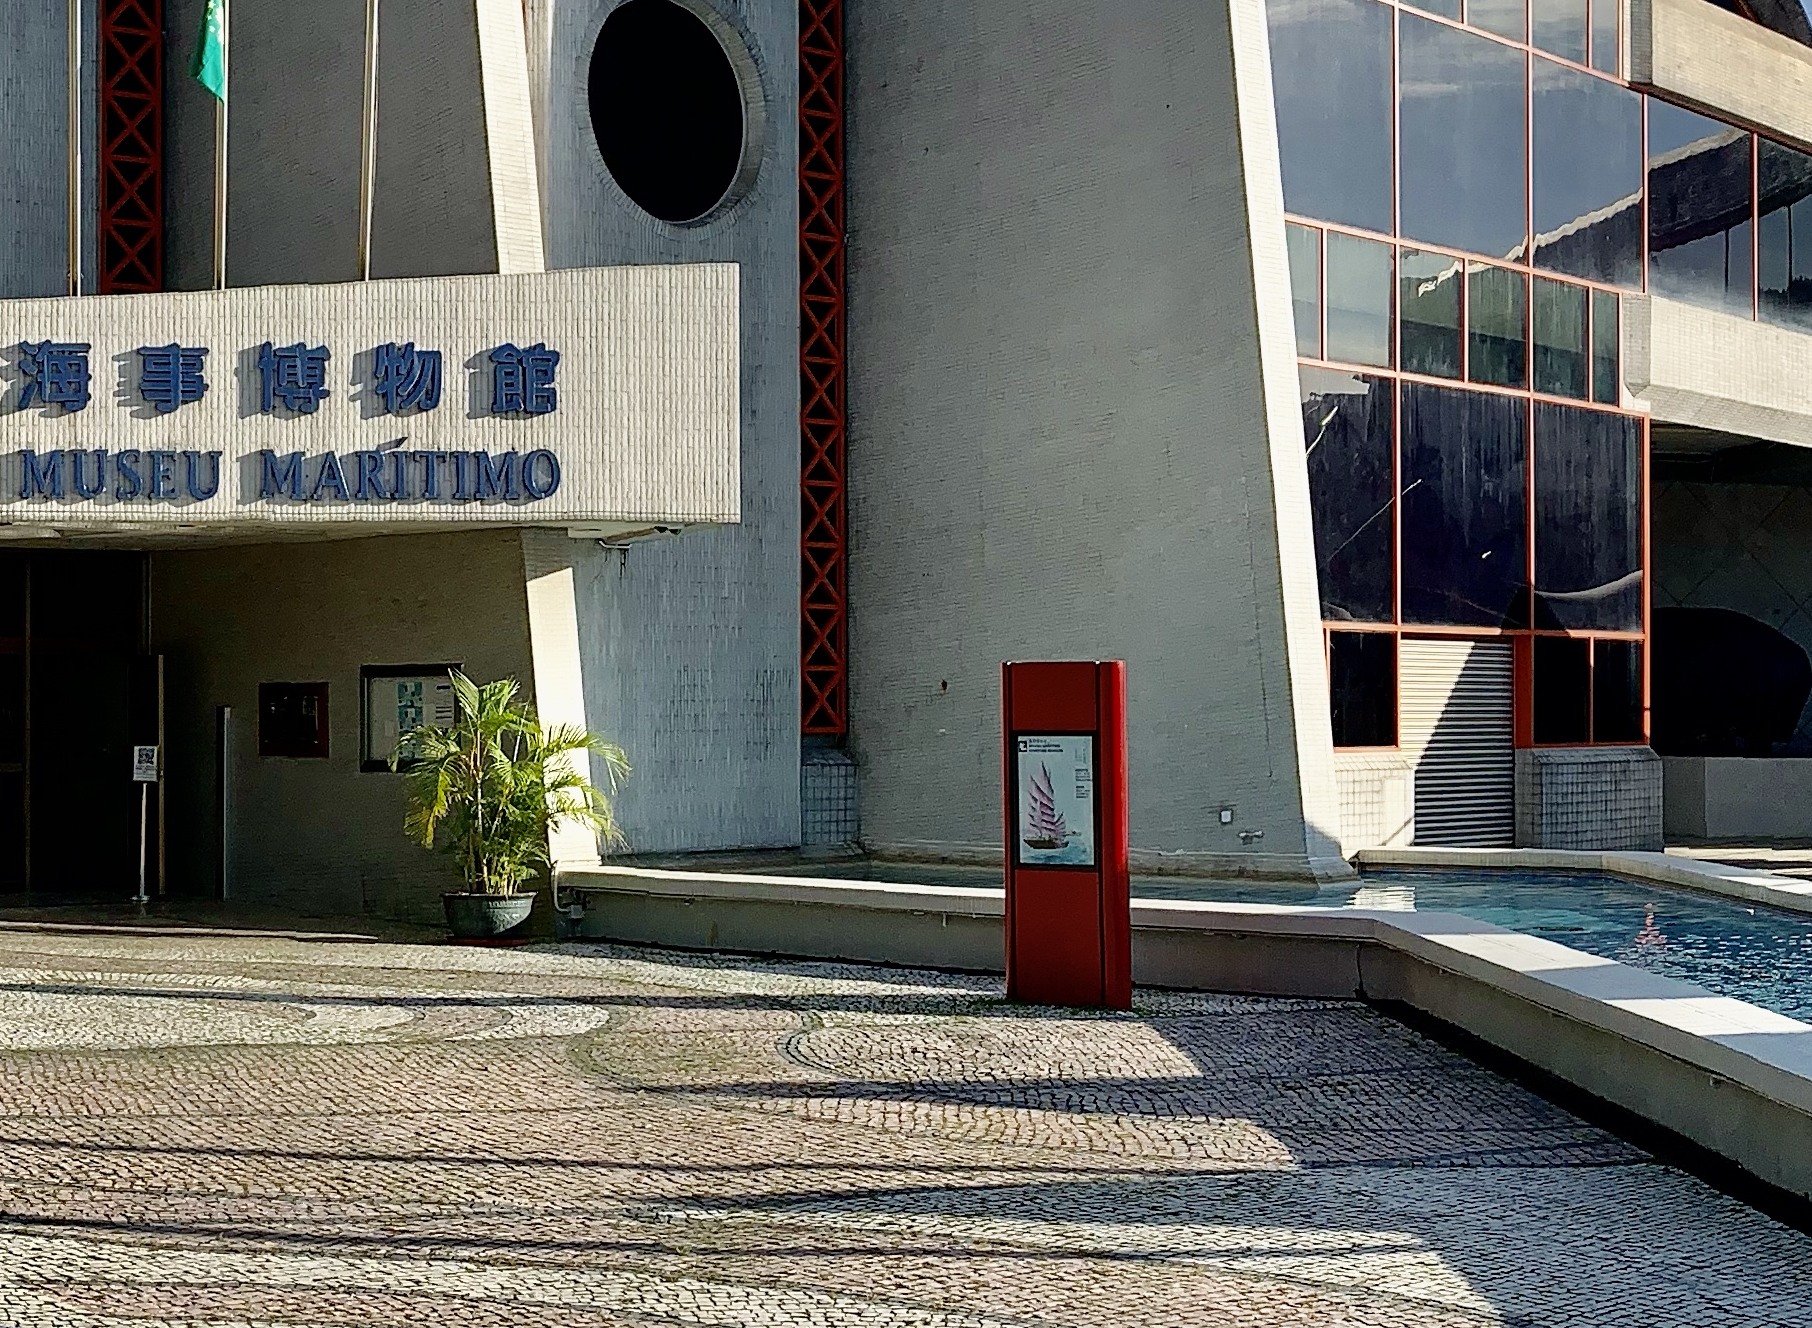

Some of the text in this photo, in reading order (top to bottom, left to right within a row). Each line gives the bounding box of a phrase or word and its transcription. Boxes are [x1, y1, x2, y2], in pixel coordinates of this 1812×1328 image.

[19, 340, 561, 413] 海事博物館
[20, 437, 561, 500] MUSEU MARÍTIMO
